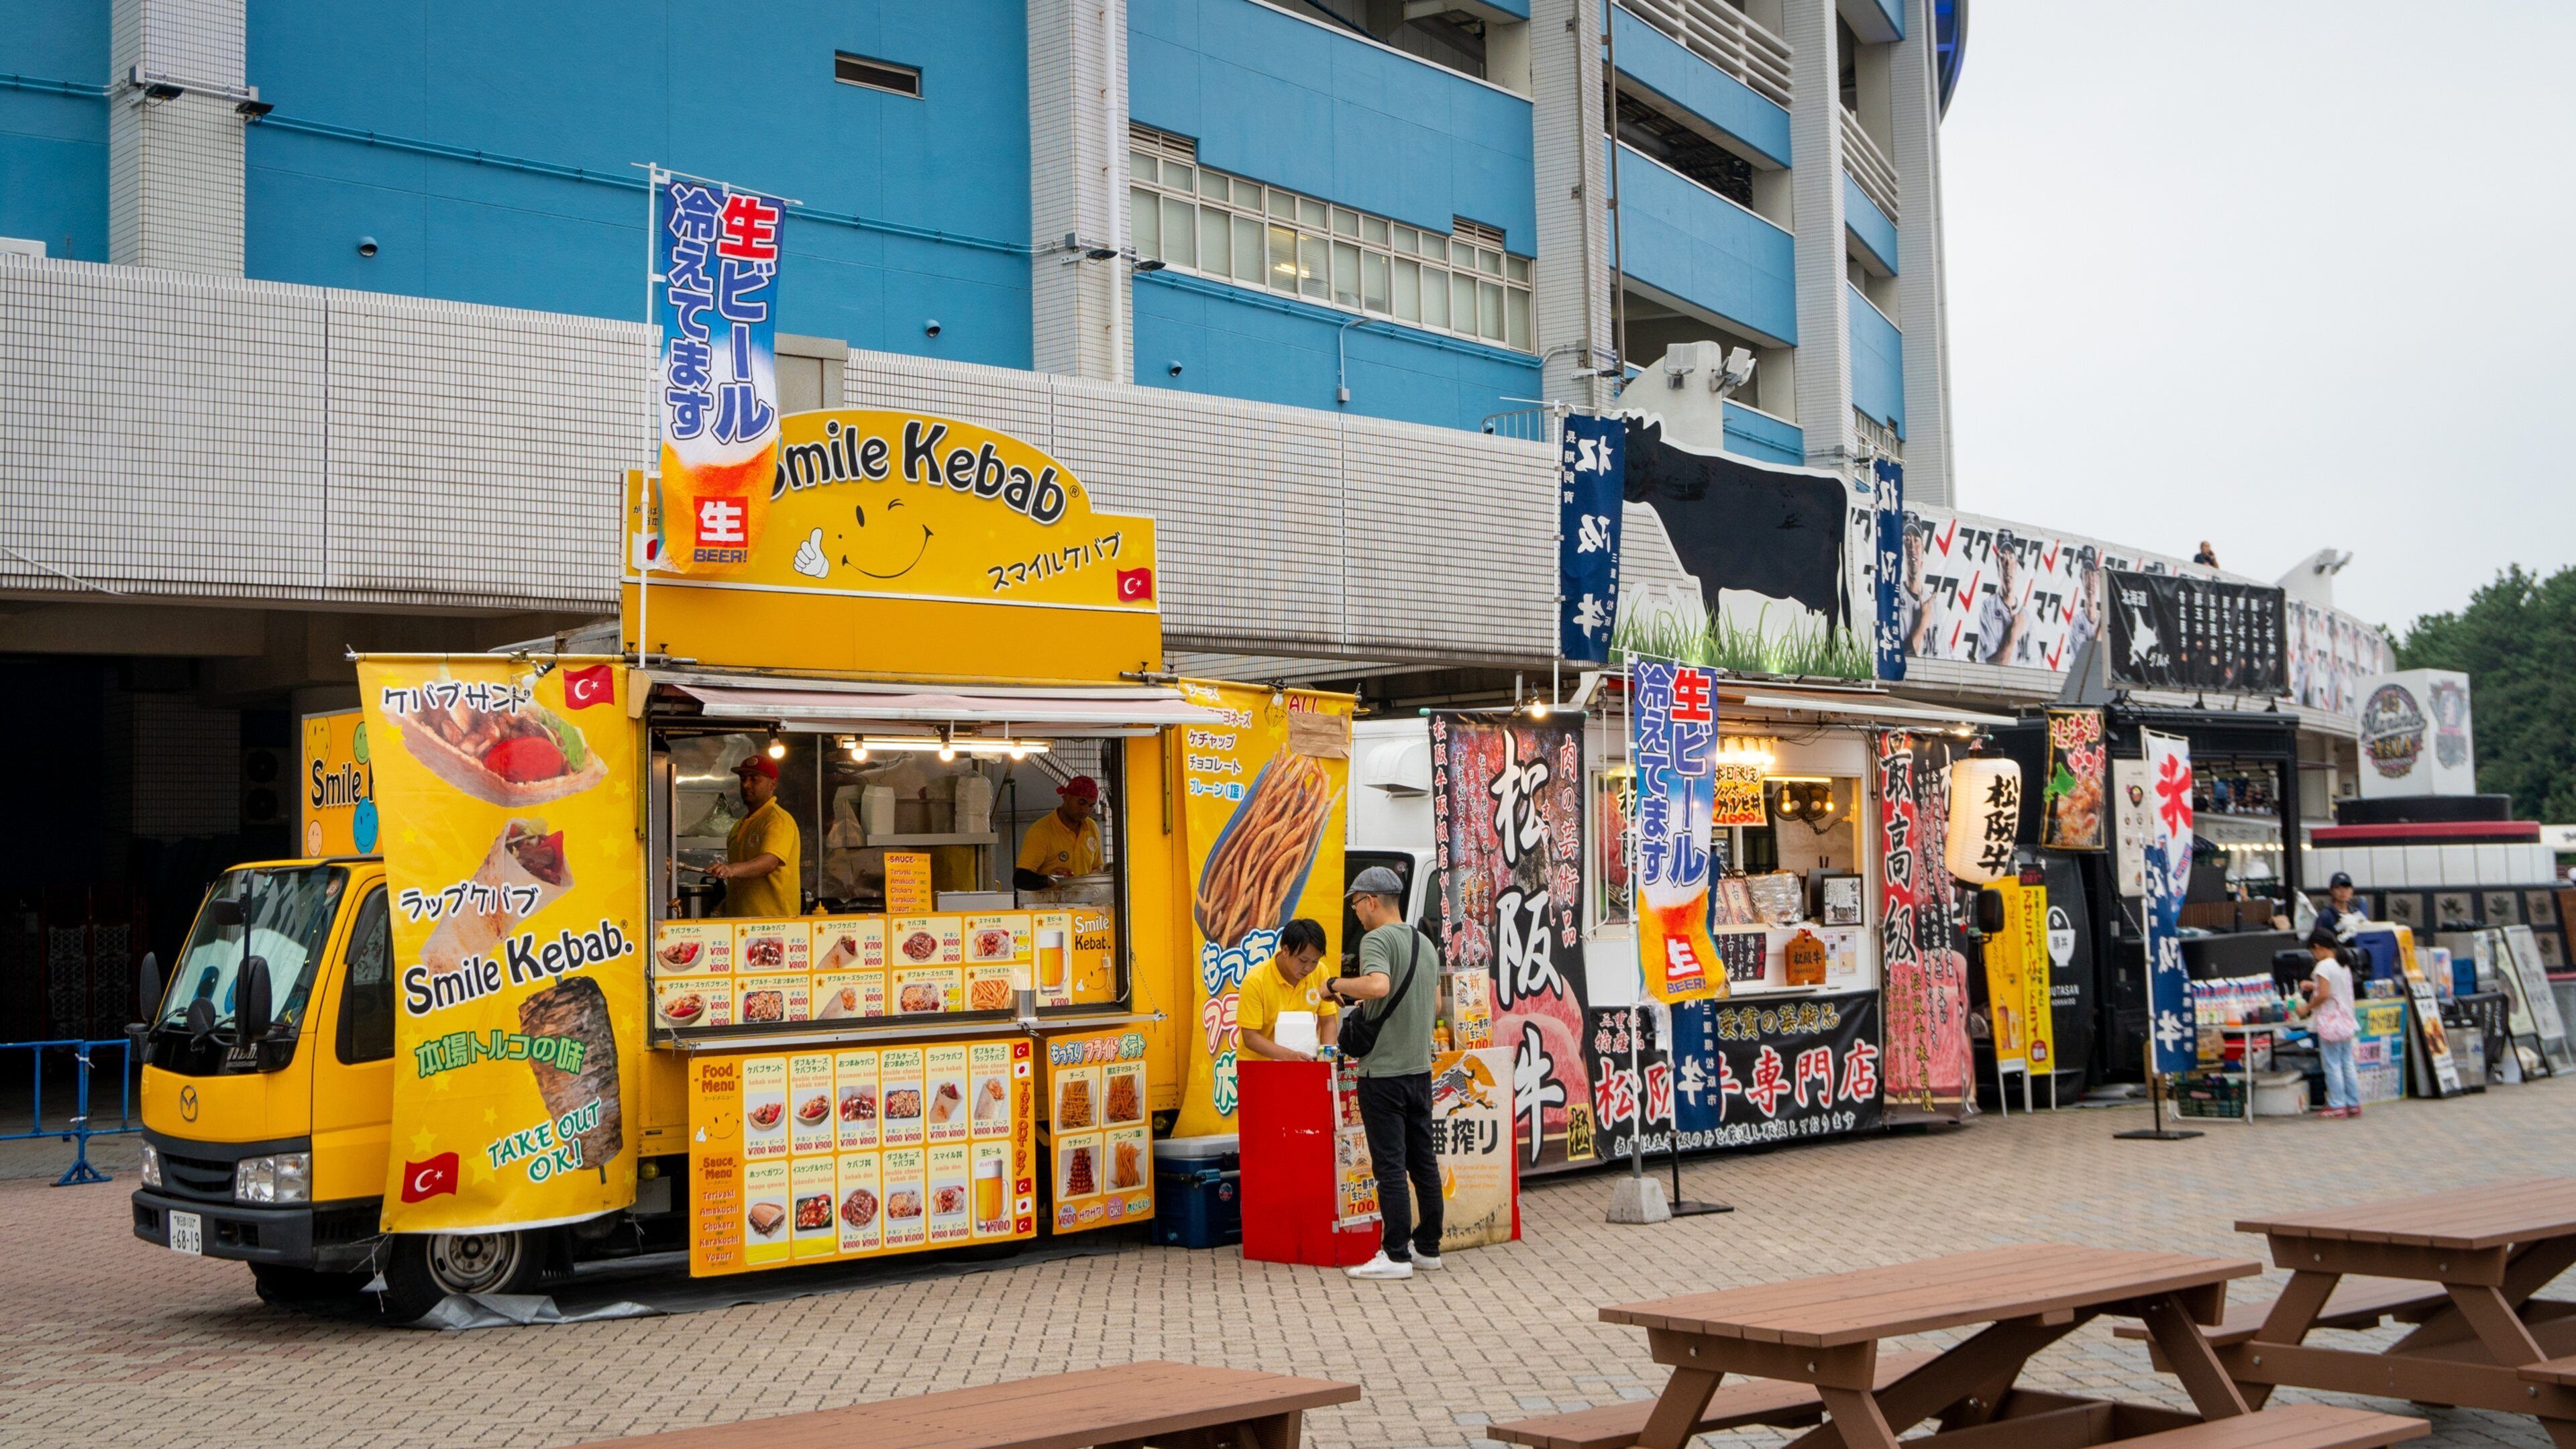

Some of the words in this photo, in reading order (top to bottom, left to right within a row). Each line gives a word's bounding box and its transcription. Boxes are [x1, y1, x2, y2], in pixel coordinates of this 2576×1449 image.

[666, 183, 722, 441] 冷えてます
[715, 194, 780, 445] 生ビール
[902, 419, 1067, 525] Kebab
[700, 501, 744, 541] 生
[694, 549, 747, 563] BEER!
[987, 531, 1122, 592] スマイルケバブ
[382, 682, 533, 715] ケバブサンド
[1186, 684, 1219, 700] チーズ
[1289, 694, 1320, 713] ALL
[1208, 708, 1252, 727] ヨネーズ
[1189, 731, 1236, 749] ケチャップ
[1189, 756, 1242, 773] チョコレート
[1638, 661, 1672, 885] 冷えてます
[1667, 666, 1713, 887] 生ビール
[311, 758, 363, 809] Smile
[1189, 780, 1246, 799] プレーン(塩)
[1977, 773, 2019, 876] 松阪牛
[1557, 733, 1580, 948] 肉の芸術品
[1879, 730, 1918, 970] 最高級
[889, 855, 914, 863] SAUCE
[399, 880, 542, 922] ラップケバブ
[1075, 915, 1110, 934] Smile
[1489, 729, 1567, 1167] 松阪牛
[1202, 928, 1283, 996] もっち
[1667, 938, 1701, 976] 生
[1746, 935, 1756, 977] 特産品
[1793, 949, 1822, 966] 松阪牛
[403, 955, 500, 1016] Smile
[1468, 972, 1481, 991] 新
[1666, 977, 1707, 994] BEER!
[414, 1028, 587, 1079] 本場トルコの味
[884, 1051, 919, 1060] ダブルチーズ
[930, 1052, 963, 1061] ラップケバブ
[973, 1046, 1006, 1055] ダブルチーズ
[974, 1053, 1006, 1062] ラップケバブ
[747, 1063, 784, 1073] ケバブサンド
[794, 1057, 828, 1066] ダブルチーズ
[794, 1064, 828, 1073] ケバブサンド
[839, 1057, 875, 1067] おつまみケバブ
[883, 1059, 920, 1068] おつまみケバブ
[702, 1063, 733, 1079] Food
[1069, 1070, 1085, 1079] チーズ
[702, 1079, 735, 1093] Menu
[1018, 1080, 1031, 1118] TAKE
[486, 1119, 553, 1169] TAKE
[556, 1098, 602, 1144] OUT
[885, 1133, 903, 1143] ¥800
[904, 1132, 922, 1141] ¥900
[930, 1130, 947, 1140] ¥700
[948, 1129, 966, 1138] ¥800
[973, 1126, 991, 1136] ¥800
[992, 1125, 1009, 1134] ¥900
[1017, 1119, 1028, 1148] OUT
[1432, 1118, 1498, 1155] 番搾り
[1570, 1108, 1589, 1154] 極
[795, 1142, 813, 1151] ¥800
[814, 1140, 833, 1150] ¥900
[840, 1138, 858, 1147] ¥700
[859, 1136, 877, 1145] ¥800
[1068, 1136, 1092, 1146] ケチャップ
[1351, 1132, 1366, 1150] 新
[747, 1146, 766, 1156] ¥700
[767, 1144, 786, 1155] ¥800
[887, 1151, 920, 1161] ダブルチーズ
[933, 1150, 963, 1161] スマイル丼
[981, 1148, 1002, 1157] 生ビール
[527, 1140, 584, 1183] OK!
[703, 1156, 734, 1168] Sauce
[792, 1163, 834, 1173] イスケンデルケバブ
[847, 1159, 872, 1169] ケバブ丼
[892, 1159, 916, 1168] ケバブ丼
[704, 1169, 733, 1180] Menu
[749, 1167, 785, 1179] ホッペガワン
[702, 1189, 735, 1201] Teriyaki
[1351, 1191, 1373, 1201] 生ビール
[700, 1204, 738, 1217] Amakuchi
[1109, 1207, 1122, 1218] OK!
[1347, 1200, 1375, 1215] 700
[1058, 1212, 1077, 1226] ¥600
[702, 1221, 736, 1232] Chukara
[985, 1220, 1010, 1233] ¥700
[886, 1234, 904, 1244] ¥900
[931, 1229, 948, 1239] ¥900
[699, 1235, 740, 1248] Karakuchi
[843, 1240, 860, 1249] ¥800
[861, 1238, 879, 1247] ¥900
[705, 1251, 733, 1262] Yogurt
